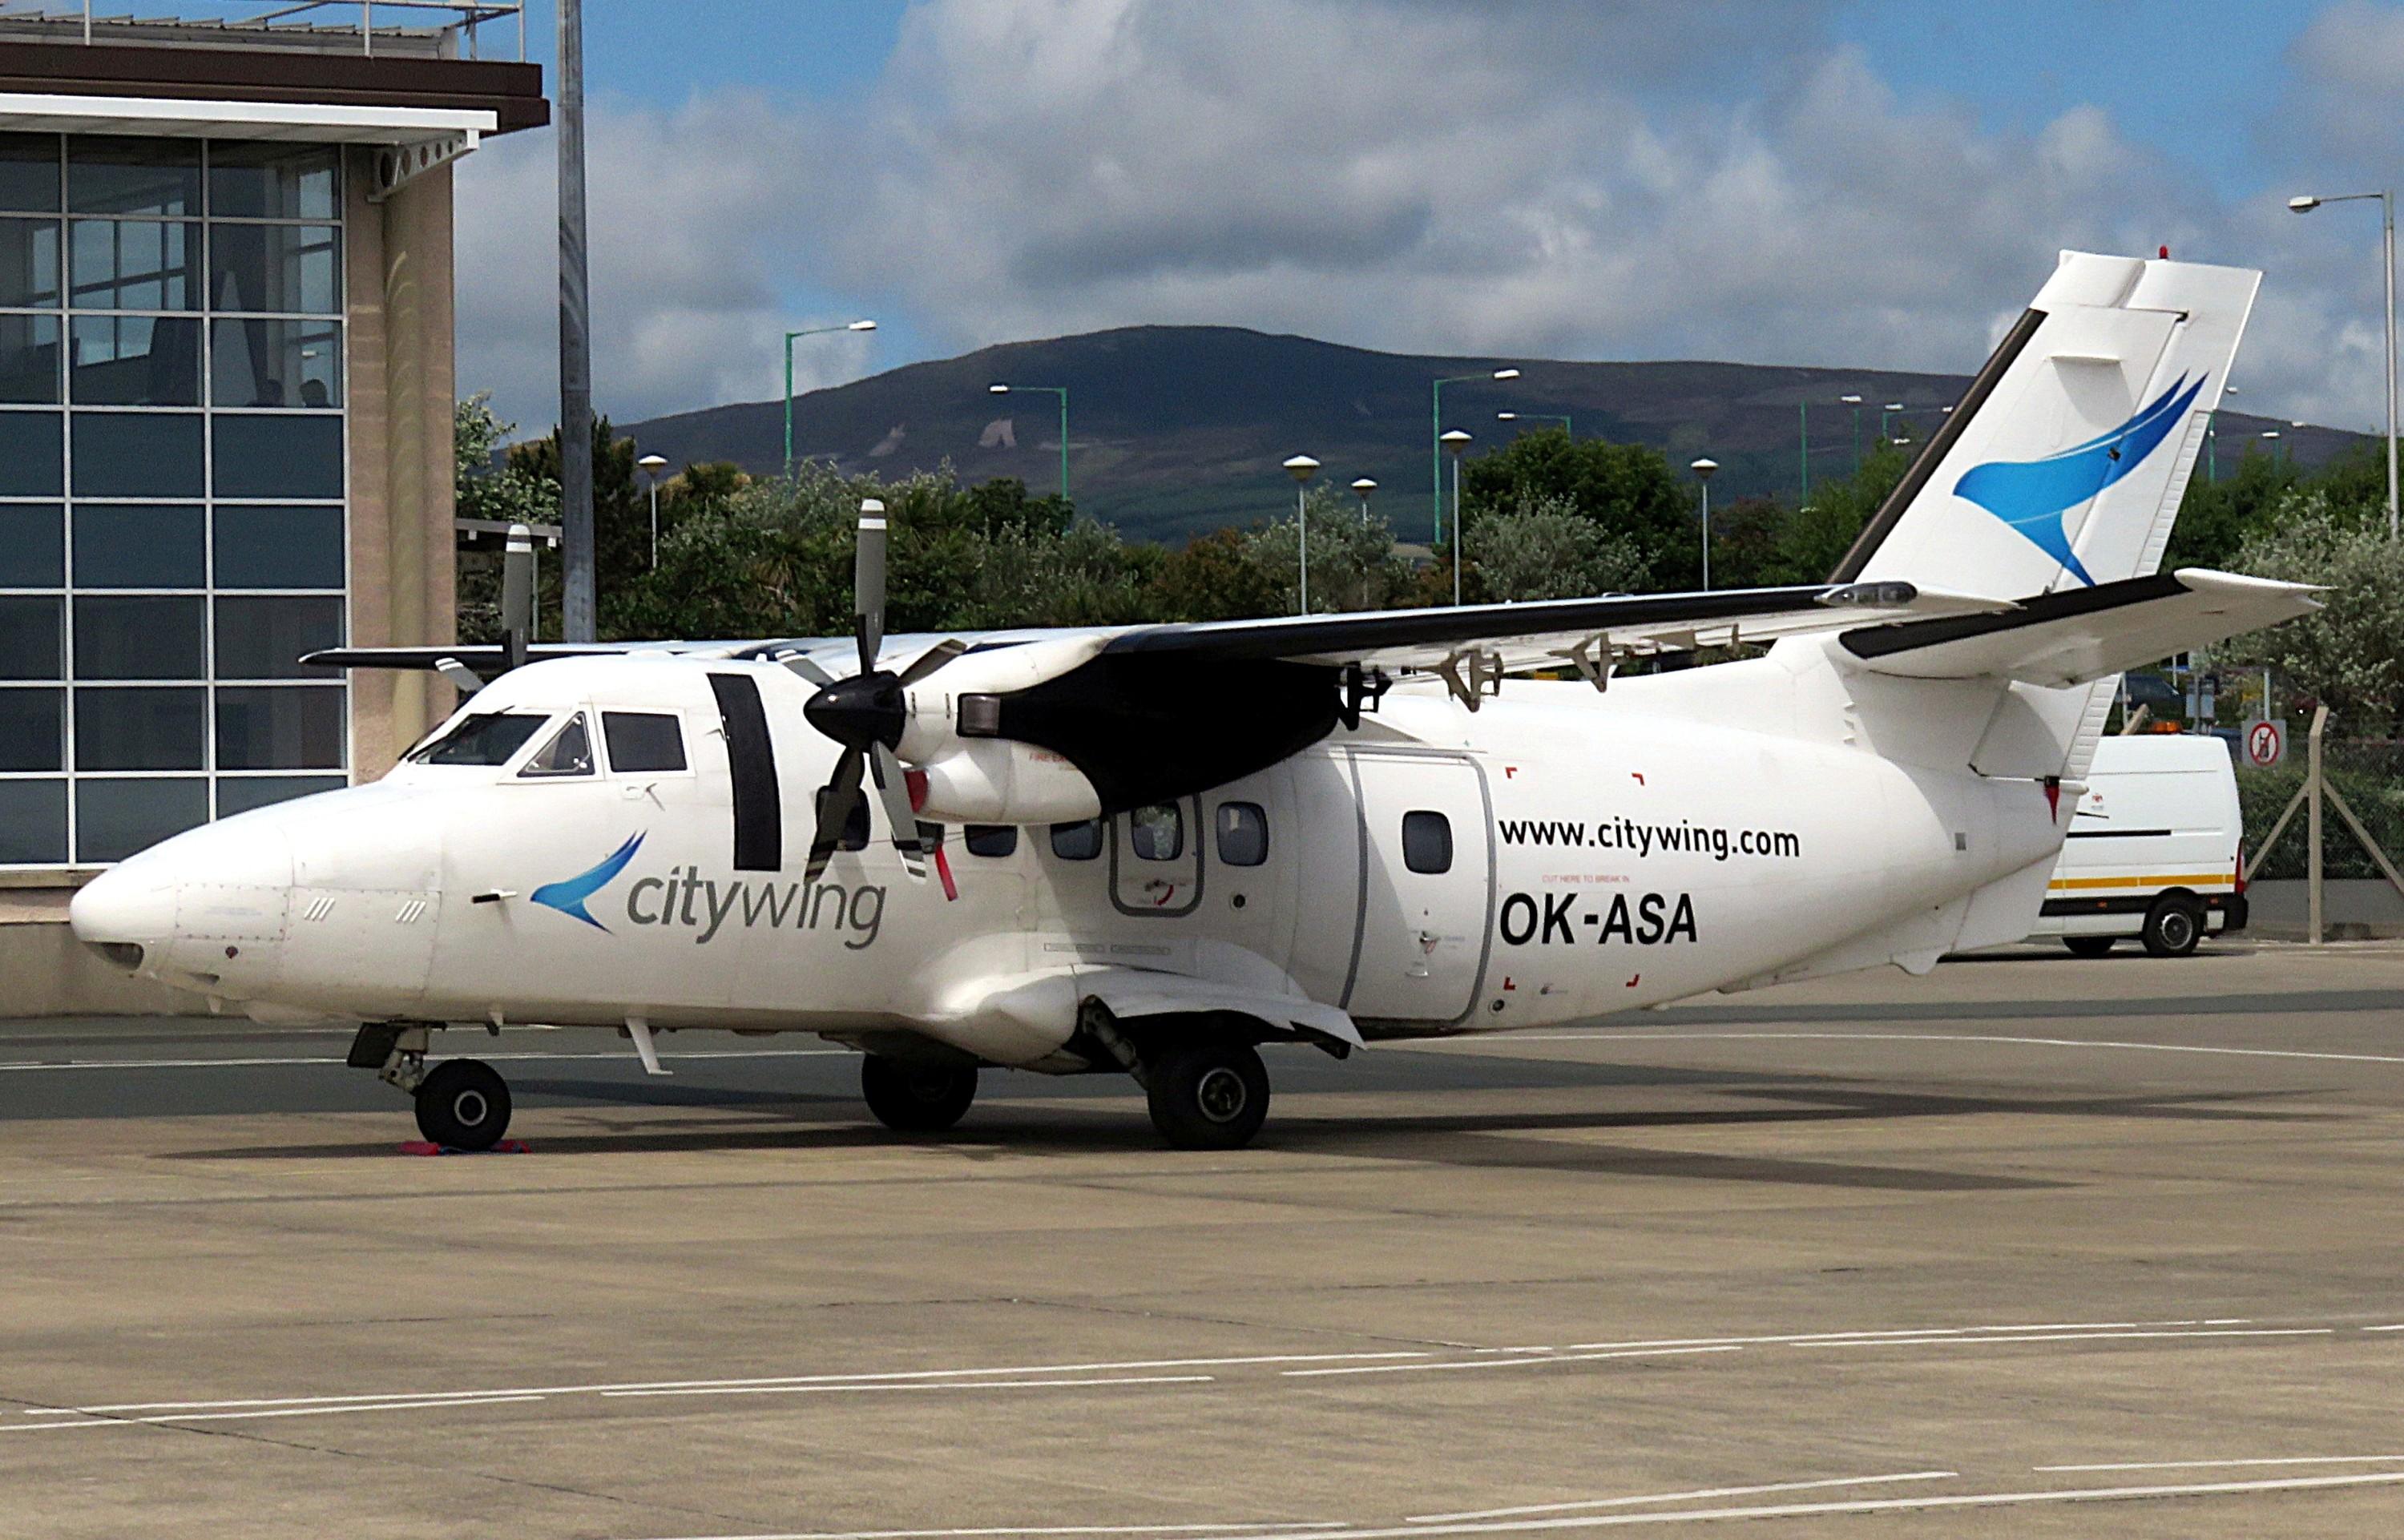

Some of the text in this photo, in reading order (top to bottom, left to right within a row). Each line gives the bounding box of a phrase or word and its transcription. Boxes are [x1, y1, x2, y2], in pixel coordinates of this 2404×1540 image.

[1498, 816, 1801, 861] www.citywing.com
[1583, 874, 1594, 884] TO
[627, 865, 886, 950] citywing
[1499, 892, 1697, 945] OK-ASA
